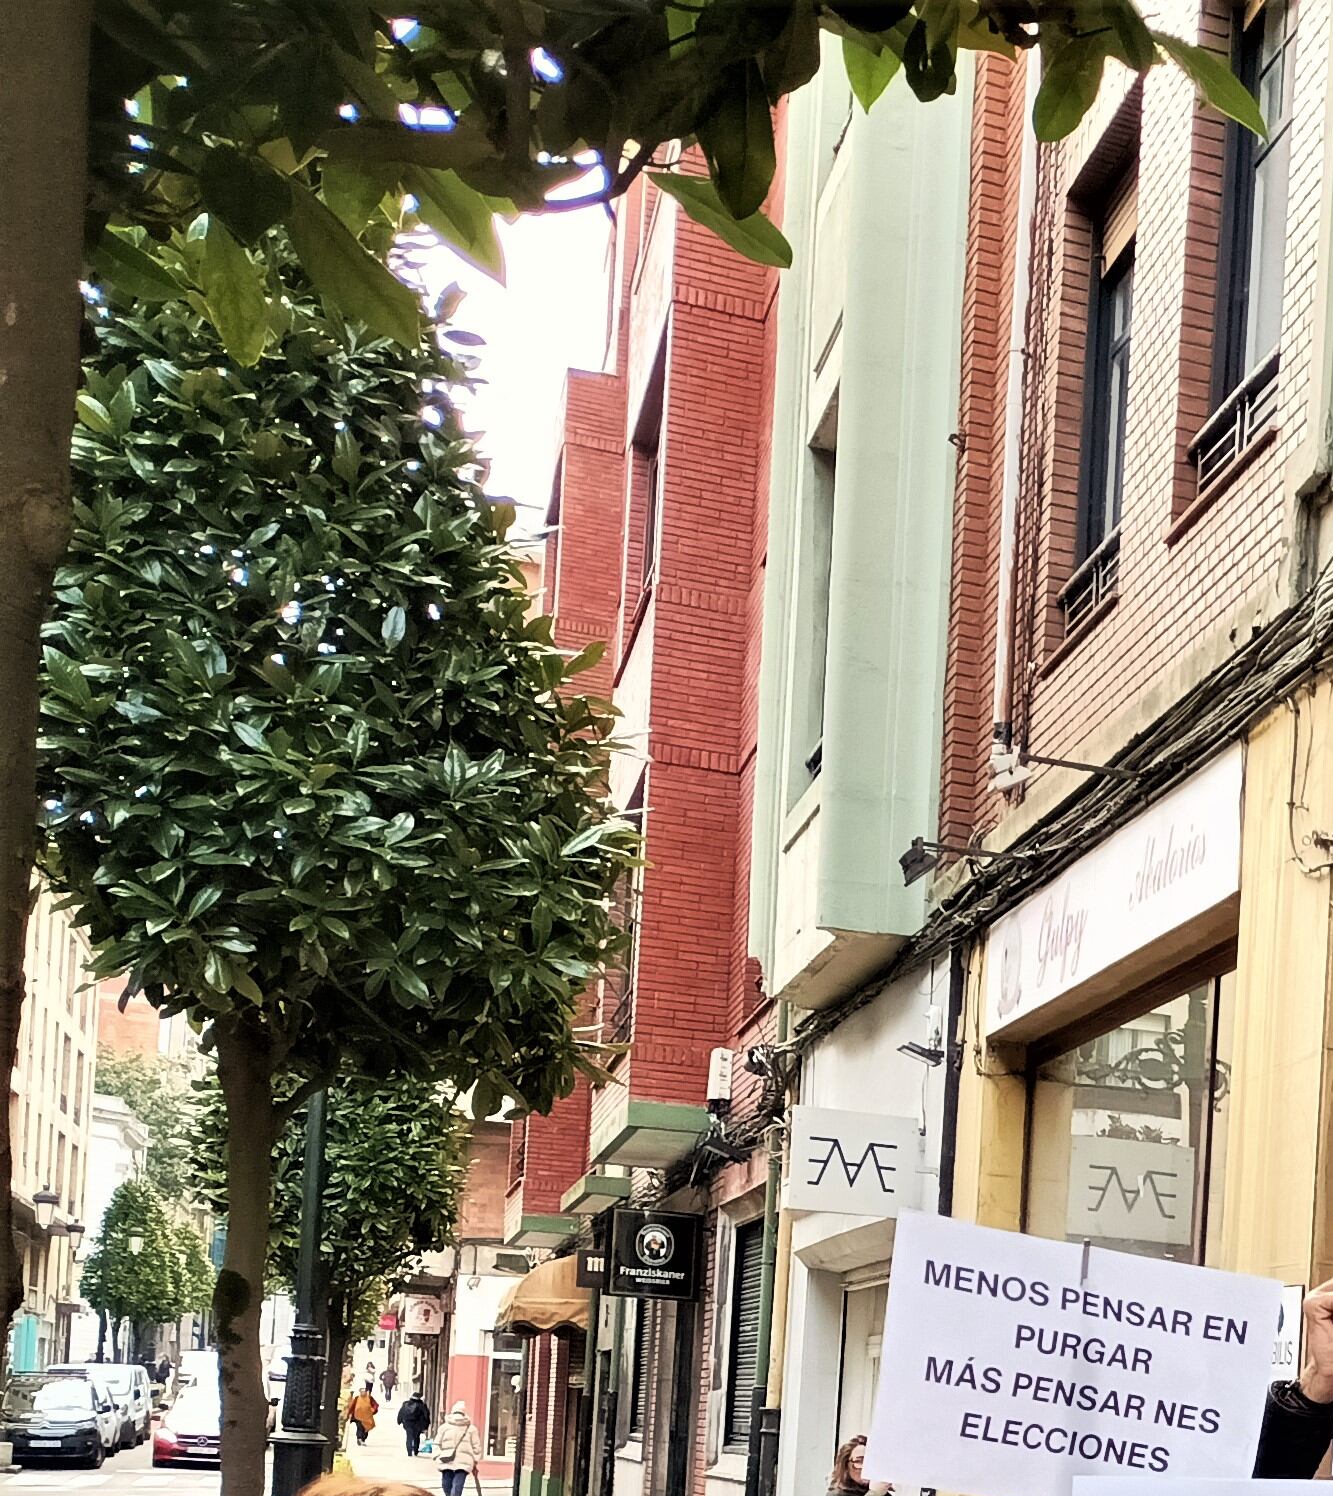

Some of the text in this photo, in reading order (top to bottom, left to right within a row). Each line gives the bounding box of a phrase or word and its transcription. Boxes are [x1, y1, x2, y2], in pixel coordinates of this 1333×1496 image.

[619, 1266, 685, 1280] Franziskaner
[924, 1259, 1248, 1344] MENOS PENSAR EN
[1014, 1325, 1153, 1374] PURGAR
[924, 1356, 1221, 1434] MÁS PENSAR NES
[959, 1412, 1171, 1472] ELECCIONES
